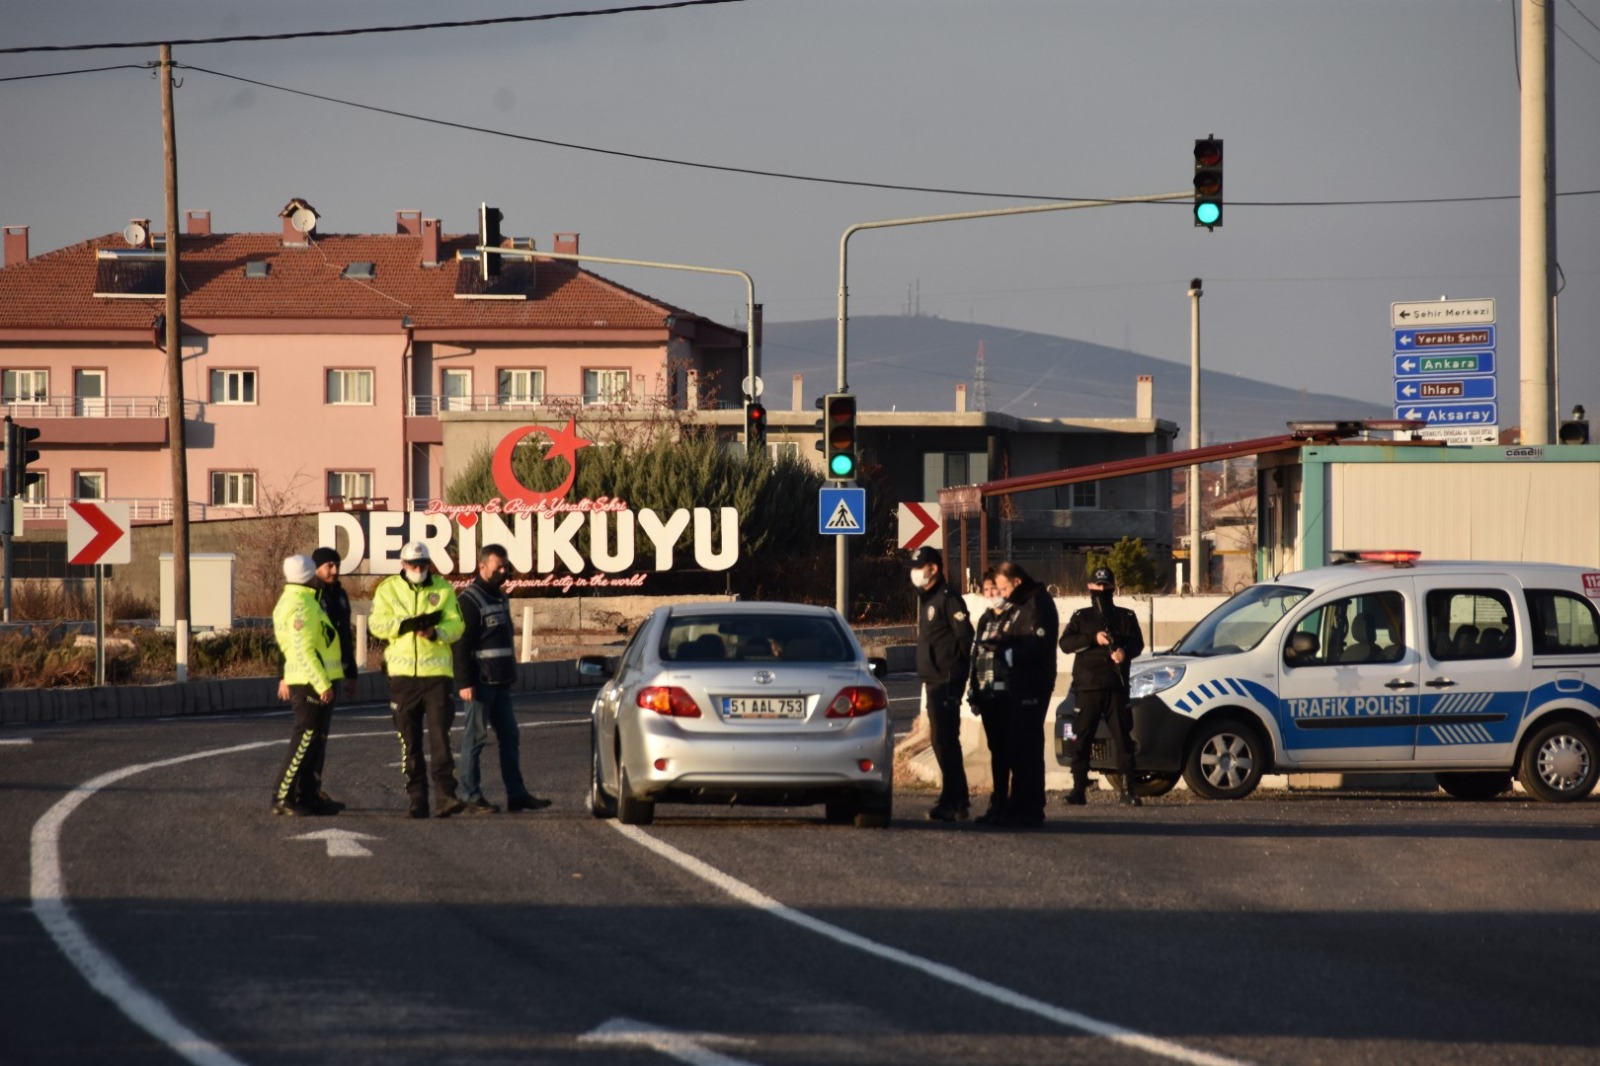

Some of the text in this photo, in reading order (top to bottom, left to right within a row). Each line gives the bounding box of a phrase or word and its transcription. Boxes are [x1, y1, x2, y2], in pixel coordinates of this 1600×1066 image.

[1413, 307, 1489, 319] Şehir Merkezi
[1458, 333, 1487, 343] Şehri
[1424, 359, 1475, 370] Ankara
[1423, 384, 1460, 395] Ihlara
[1427, 409, 1490, 422] Aksaray
[484, 498, 502, 513] En
[504, 498, 548, 519] Büyük
[576, 576, 588, 587] in
[588, 573, 609, 587] the
[610, 573, 647, 587] world
[731, 697, 803, 713] 51 AAL 753
